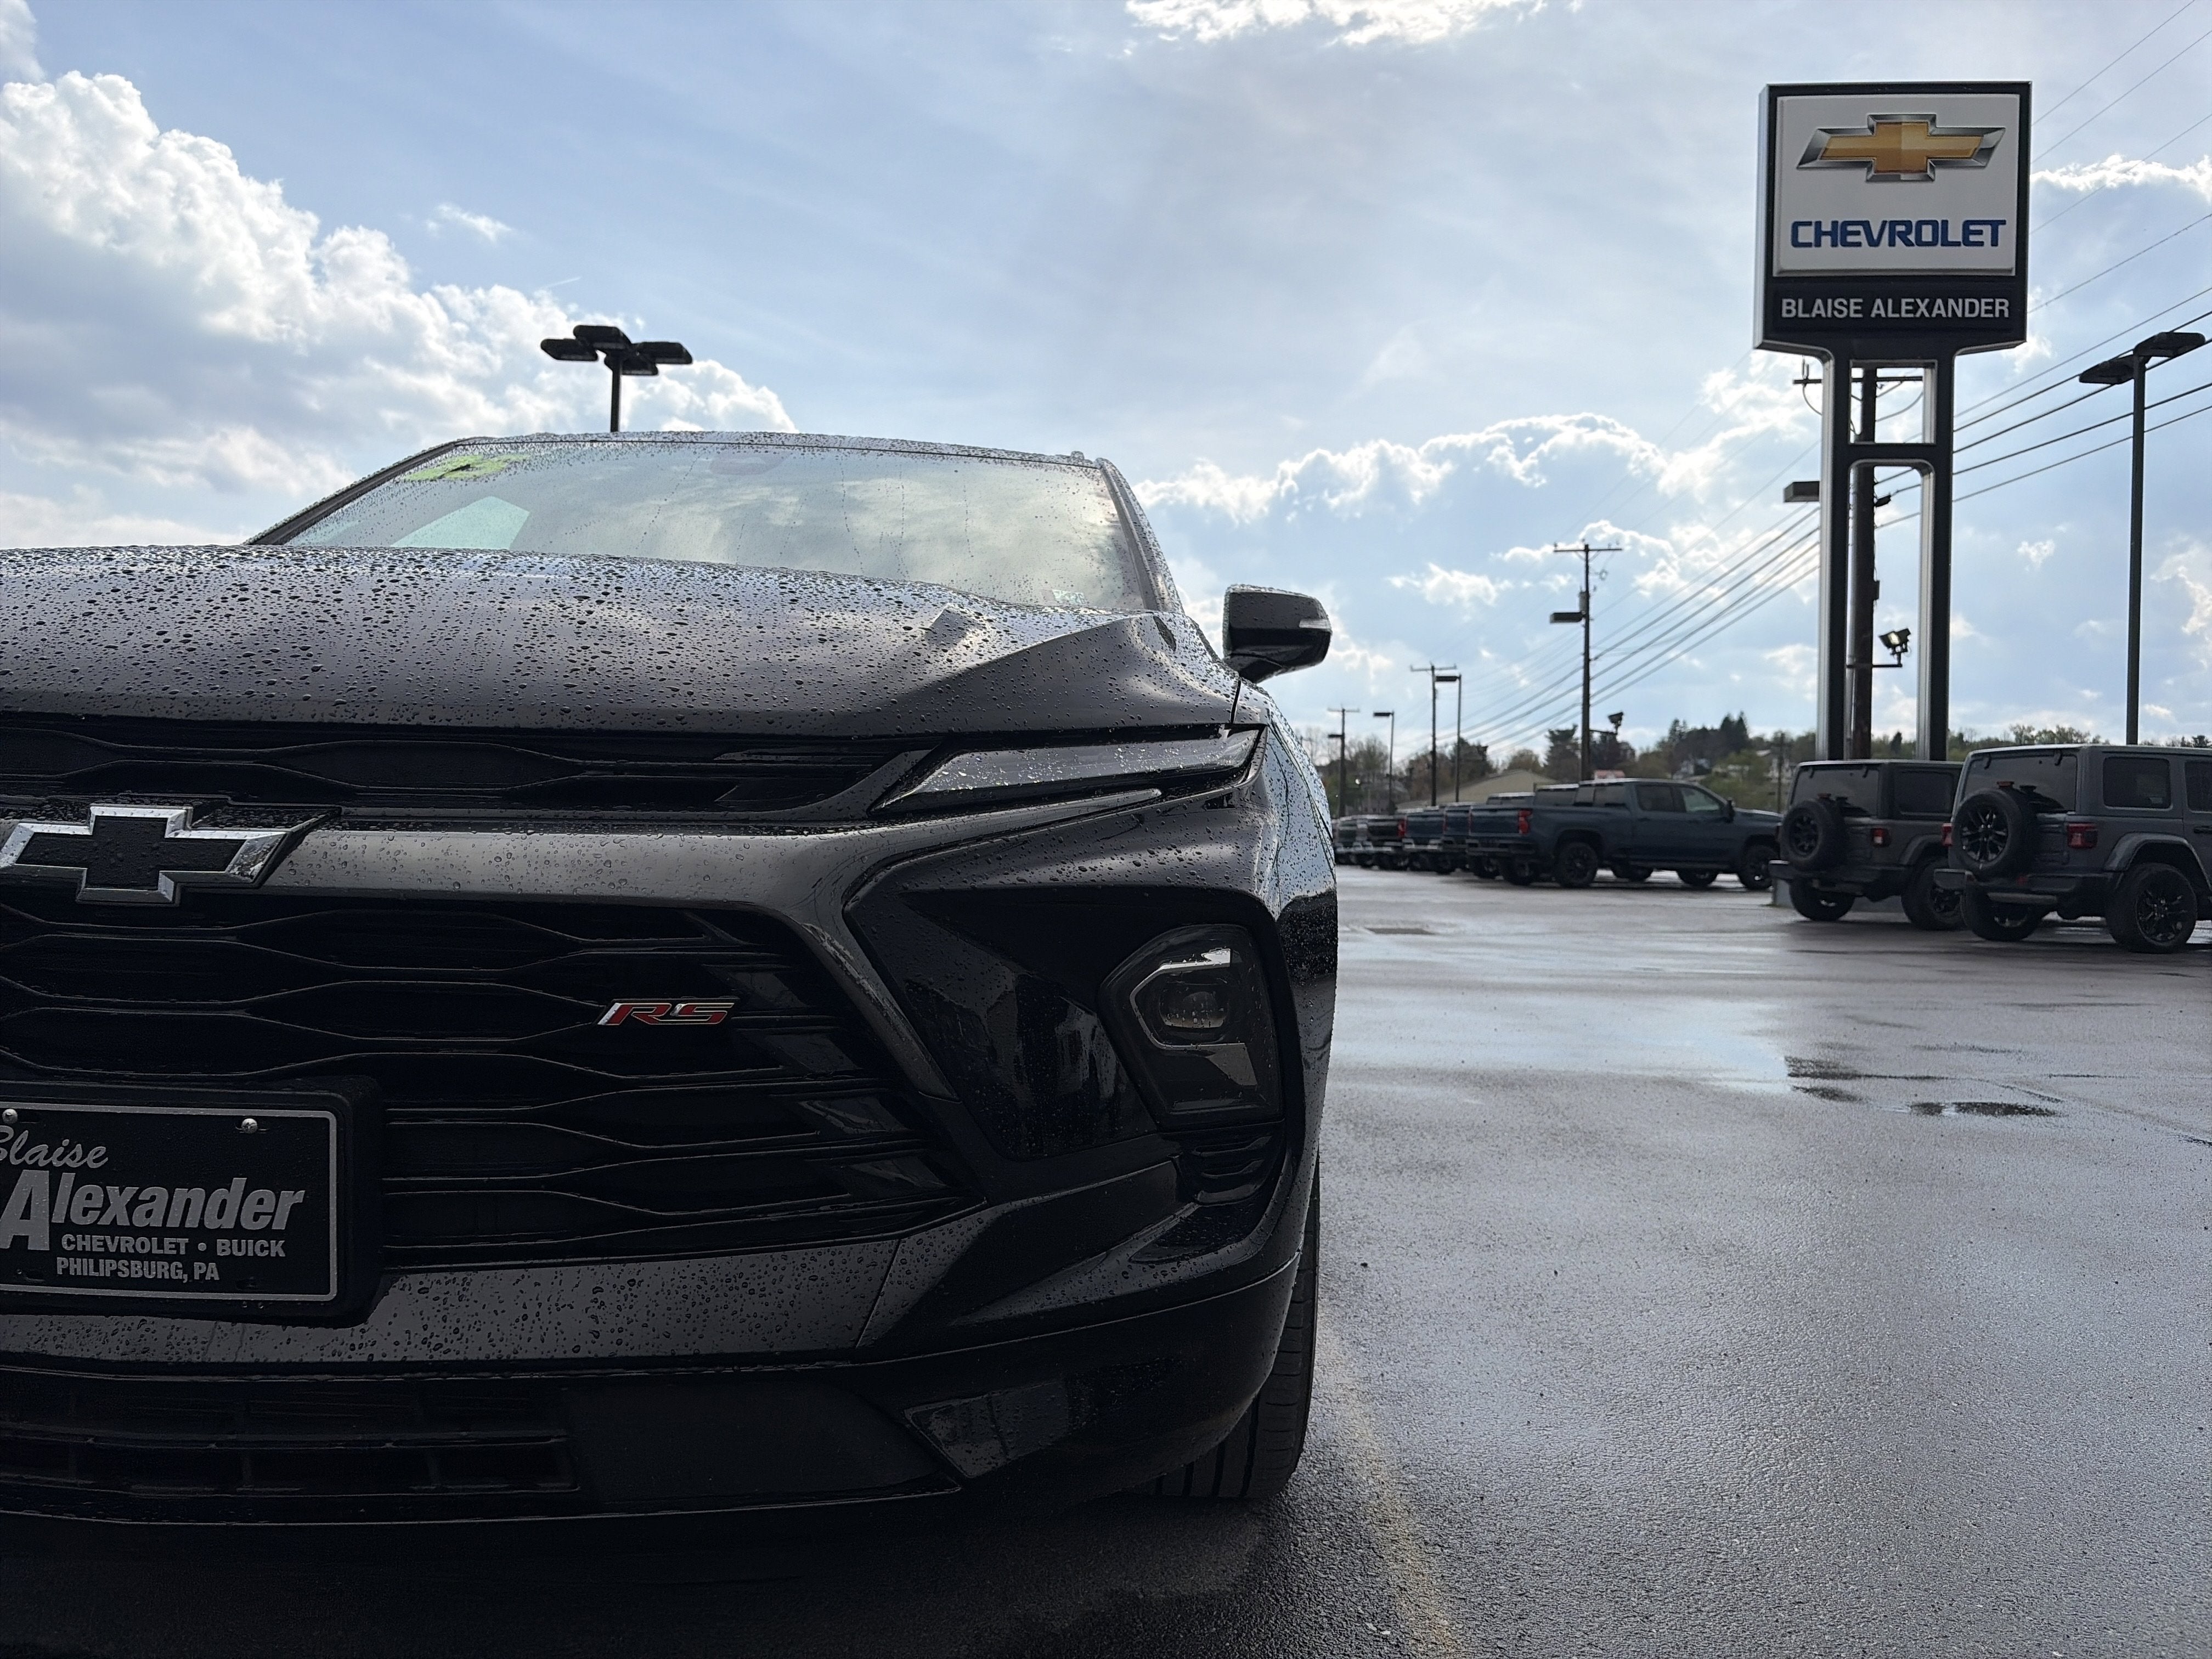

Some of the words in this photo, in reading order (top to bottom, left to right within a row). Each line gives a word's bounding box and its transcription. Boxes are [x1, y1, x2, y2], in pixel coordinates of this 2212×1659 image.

[1791, 220, 2006, 247] CHEVROLET
[1781, 298, 1863, 318] BLAISE
[1870, 298, 2010, 318] ALEXANDER
[597, 1003, 735, 1025] RS
[0, 1169, 305, 1250] Alexander
[61, 1234, 189, 1255] CHEVROLET
[216, 1239, 285, 1257] BUICK
[57, 1257, 188, 1283] PHILIPSBURG,
[194, 1262, 219, 1280] PA
